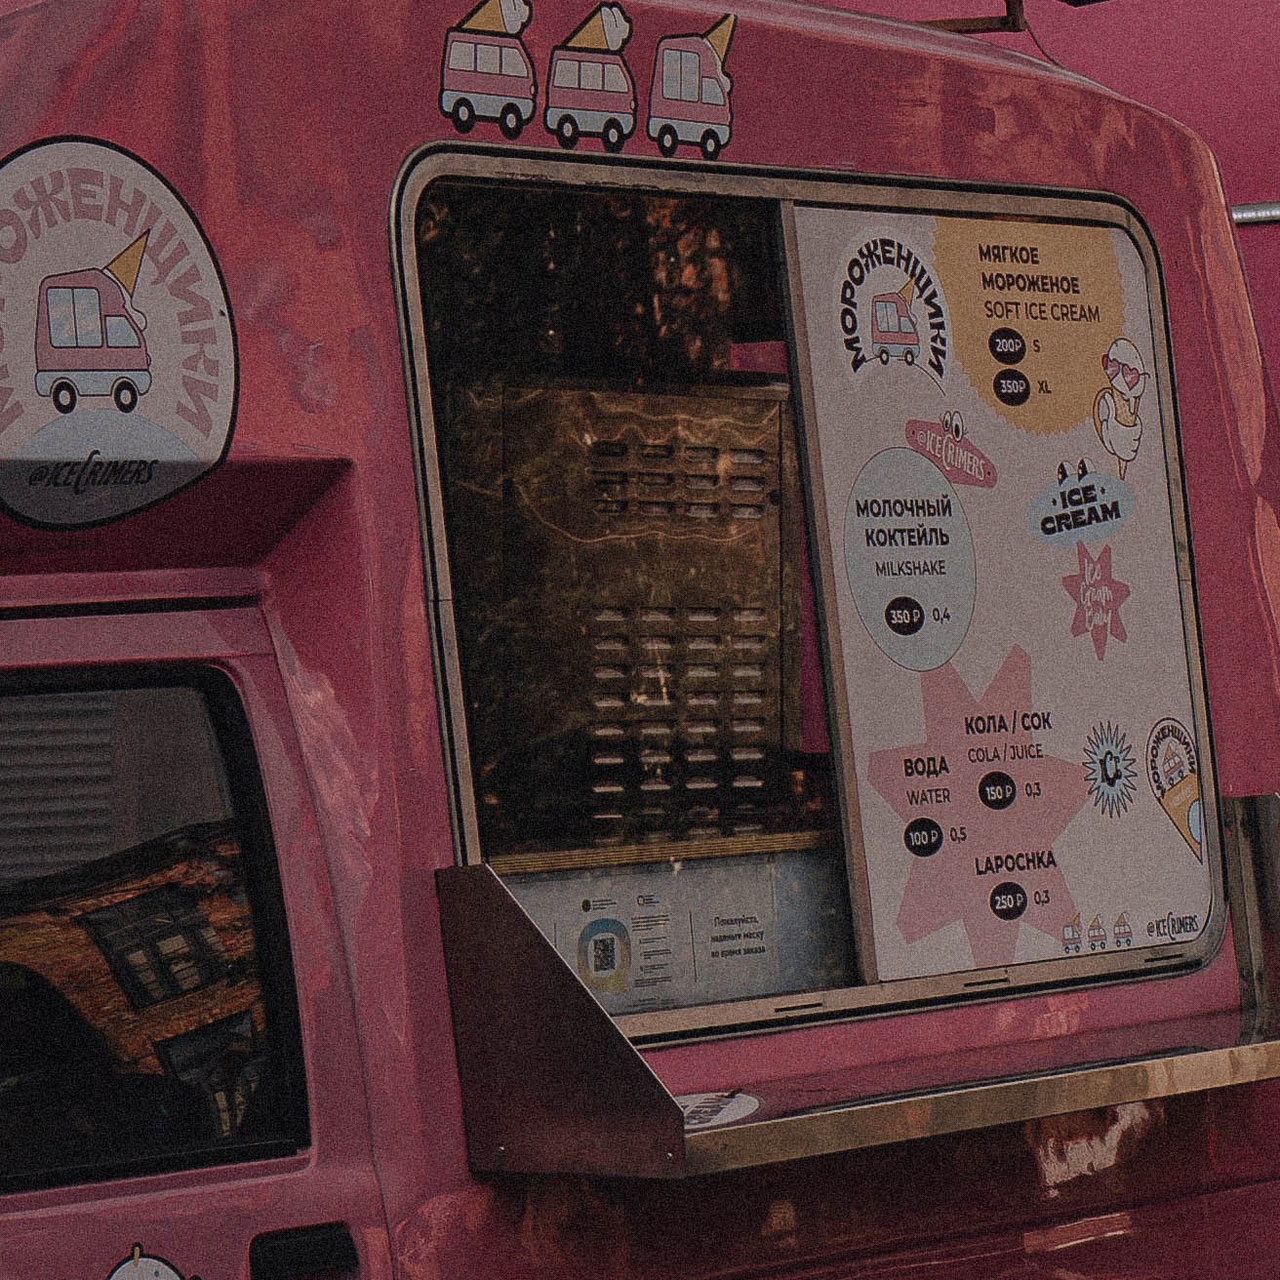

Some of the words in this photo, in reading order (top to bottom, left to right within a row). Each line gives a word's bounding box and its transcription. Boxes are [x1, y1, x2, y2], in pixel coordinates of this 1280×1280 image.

[979, 244, 1039, 264] МЯГКОЕ
[982, 272, 1080, 294] МОРОЖЕНОЕ
[984, 300, 1020, 319] SOFT
[1025, 302, 1047, 320] ICE
[1051, 303, 1100, 322] CREAM
[1037, 380, 1052, 394] XL
[856, 494, 952, 518] МОЛОЧНЫЙ
[1059, 484, 1098, 509] ICE
[1041, 500, 1121, 535] CREAM
[865, 523, 950, 547] КОКТЕЙЛЬ
[875, 560, 946, 577] MILKSHAKE
[889, 609, 910, 624] 350
[1022, 711, 1052, 731] СОК
[968, 746, 1001, 763] COLA
[1010, 744, 1044, 760] JUICE
[904, 756, 950, 778] ВОДА
[906, 787, 951, 805] WATER
[985, 785, 1003, 800] 150
[909, 831, 929, 846] 100
[975, 851, 1057, 875] LAPOCHKA
[994, 893, 1015, 909] 250
